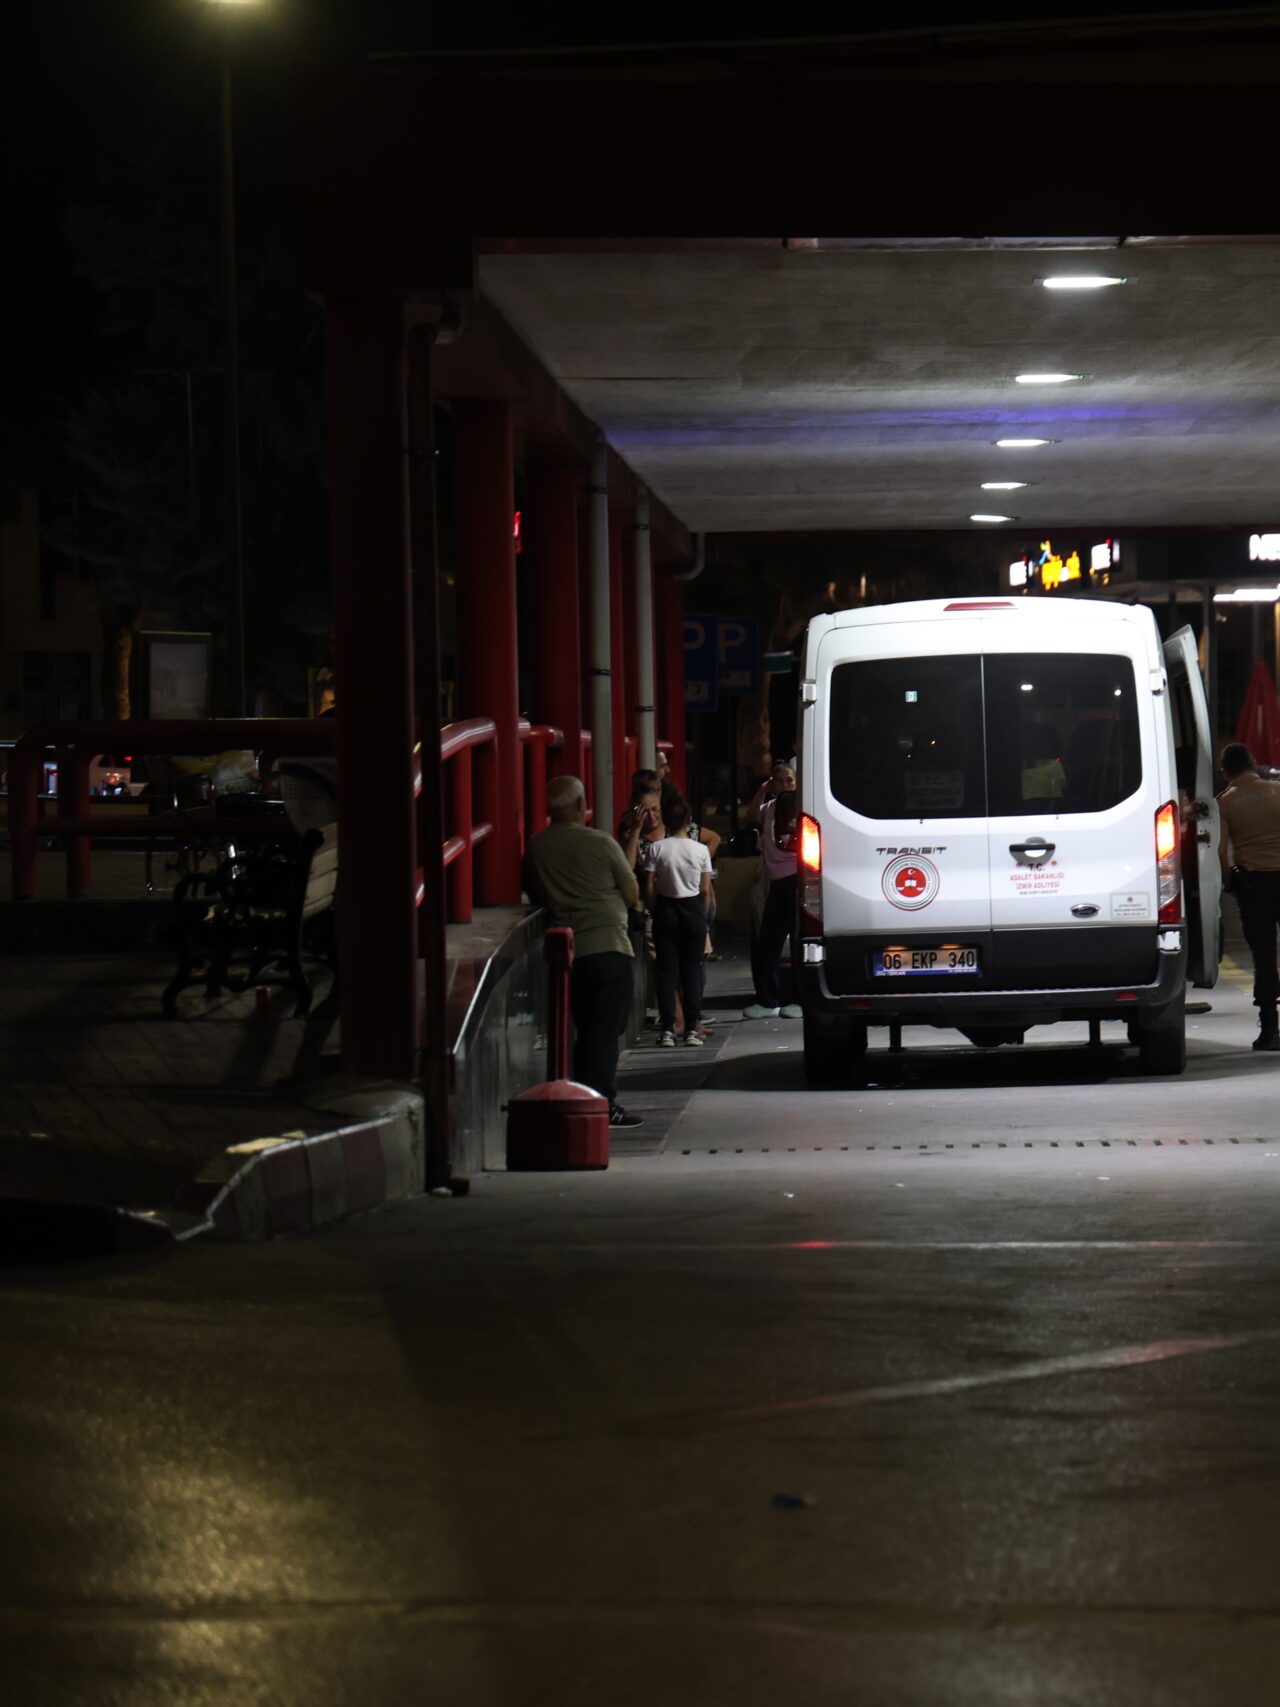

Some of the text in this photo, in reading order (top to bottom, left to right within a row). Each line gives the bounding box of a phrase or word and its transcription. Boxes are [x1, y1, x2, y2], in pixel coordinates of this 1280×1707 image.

[876, 846, 947, 855] TRANSIT
[884, 951, 975, 969] 06 EKP 340
